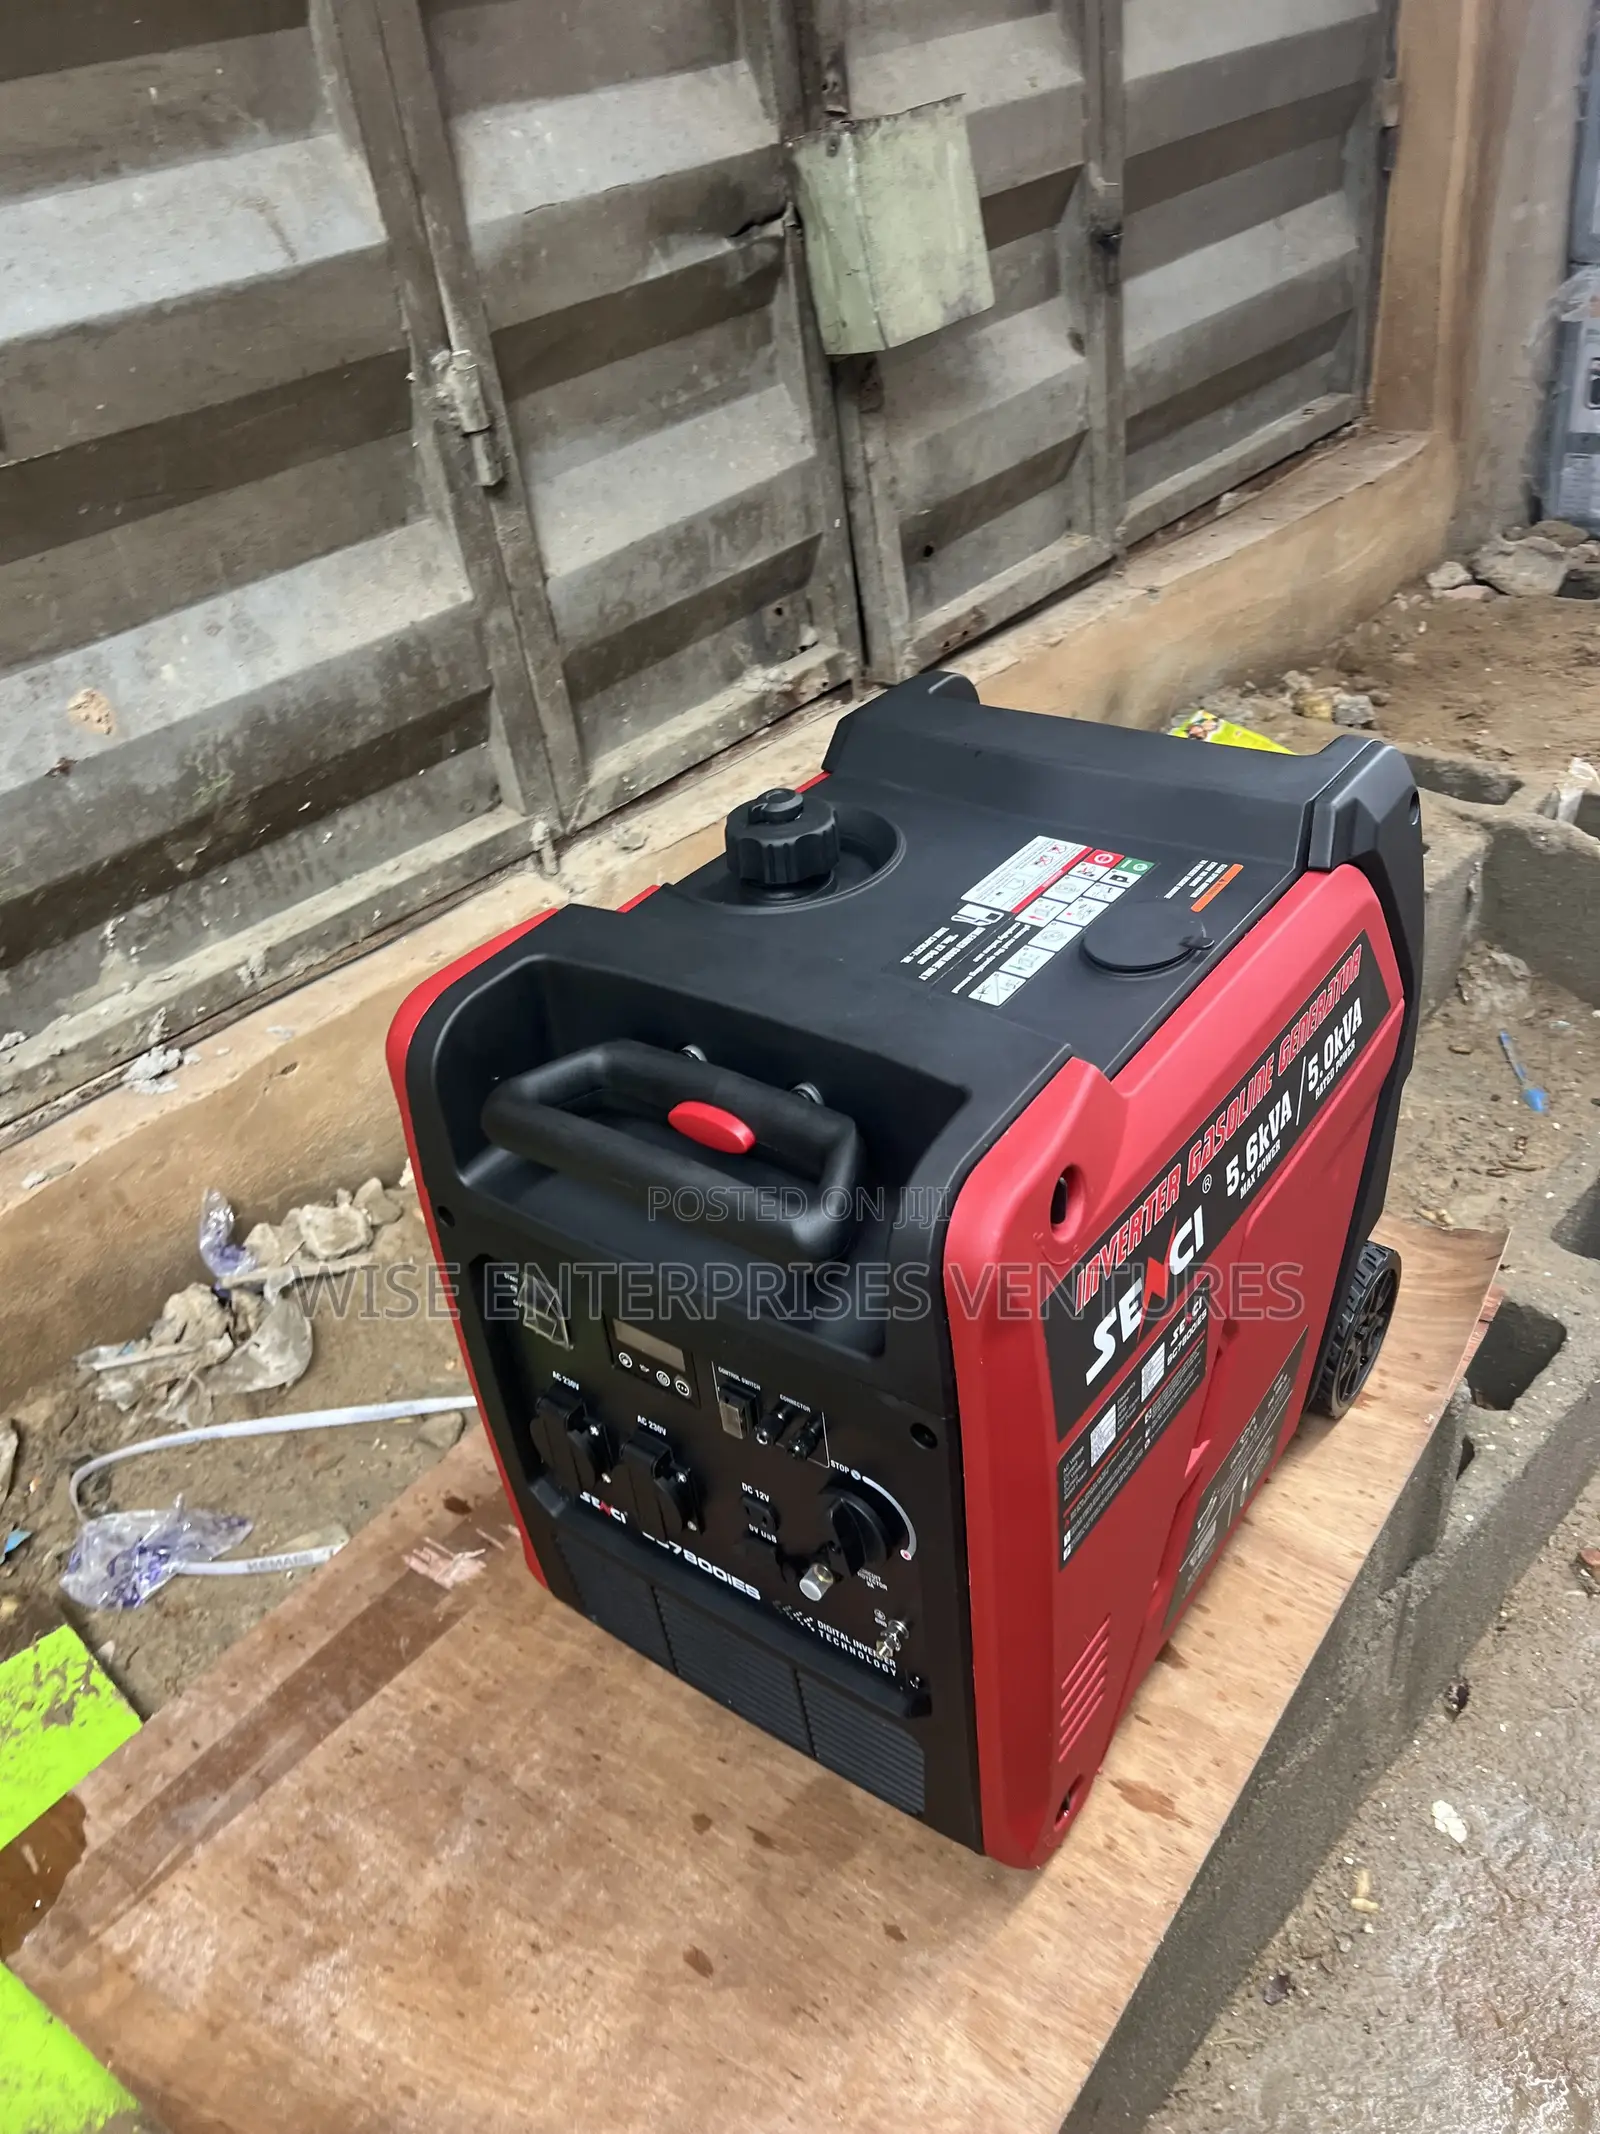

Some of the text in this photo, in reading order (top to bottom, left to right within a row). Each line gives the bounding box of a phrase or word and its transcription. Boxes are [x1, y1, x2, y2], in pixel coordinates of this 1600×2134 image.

[1335, 1038, 1356, 1075] POWER
[1225, 1090, 1293, 1197] 5.6kVA
[1307, 997, 1363, 1093] 5.0kVA
[1075, 1163, 1181, 1316] INVERTER
[1187, 1052, 1275, 1186] GASOLINE
[1277, 943, 1362, 1077] GENERATOR
[1240, 1138, 1281, 1200] MAX POWER
[637, 1415, 648, 1427] AC
[830, 1459, 850, 1475] STOP
[741, 1482, 770, 1503] DC 12V
[817, 1620, 852, 1645] DIGITAL
[819, 1629, 897, 1677] TECHNOLOGY
